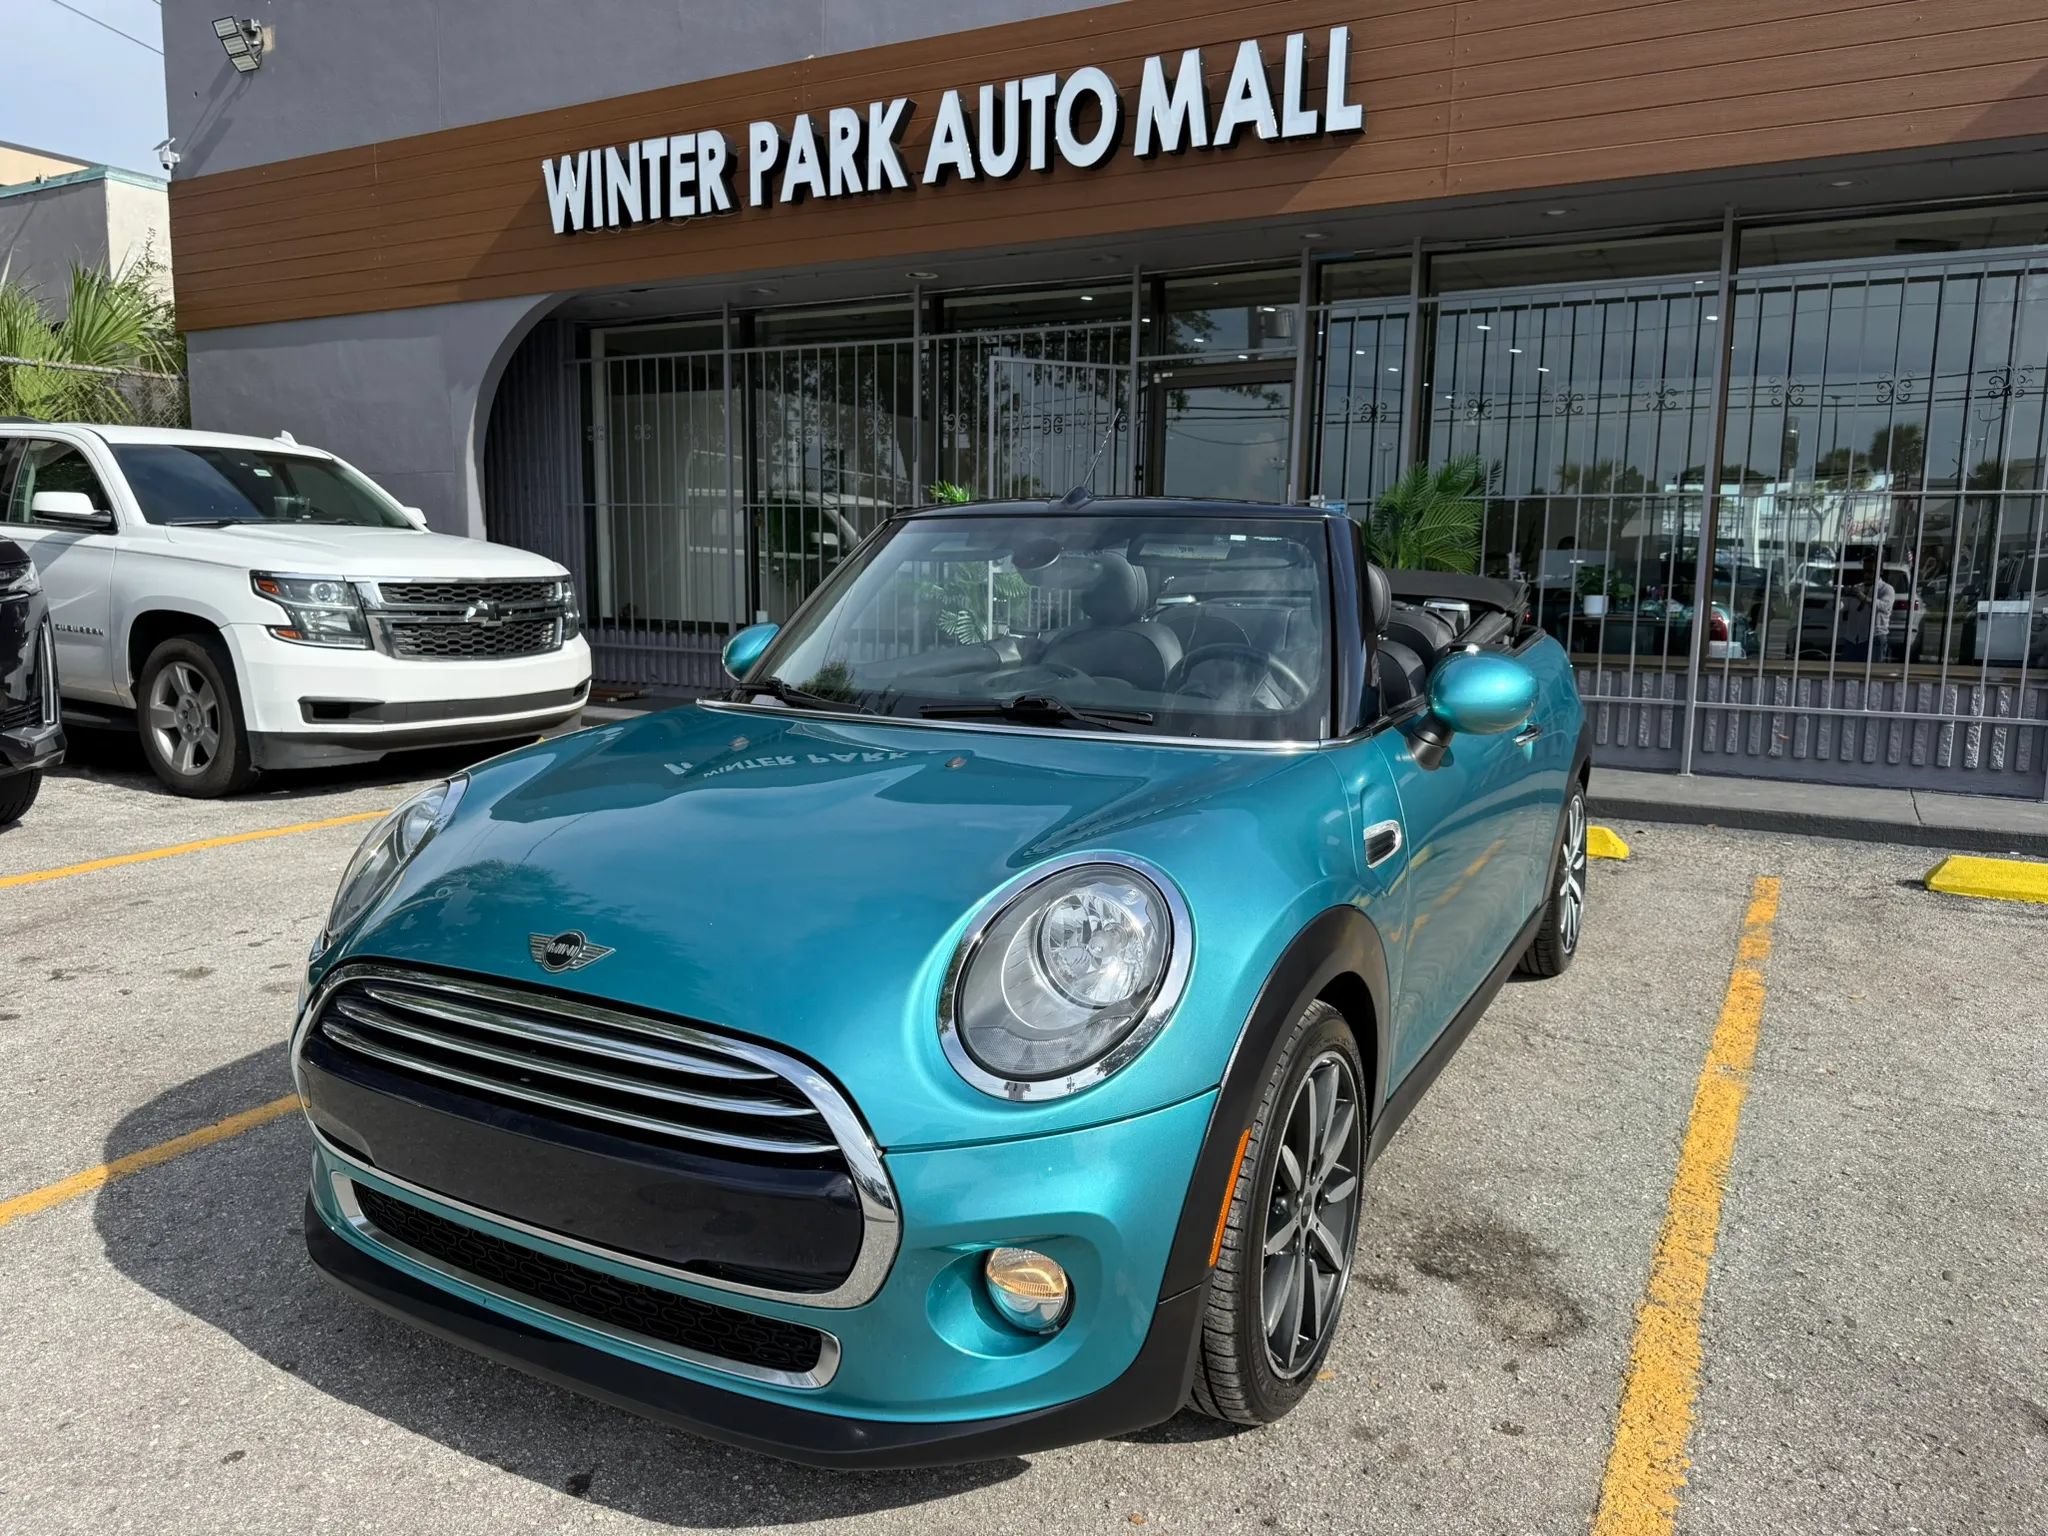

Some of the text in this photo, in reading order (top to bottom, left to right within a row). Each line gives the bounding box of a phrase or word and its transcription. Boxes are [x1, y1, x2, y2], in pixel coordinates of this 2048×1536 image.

[543, 26, 1364, 234] WINTER PARK AUTO MALL
[547, 942, 579, 957] MINI
